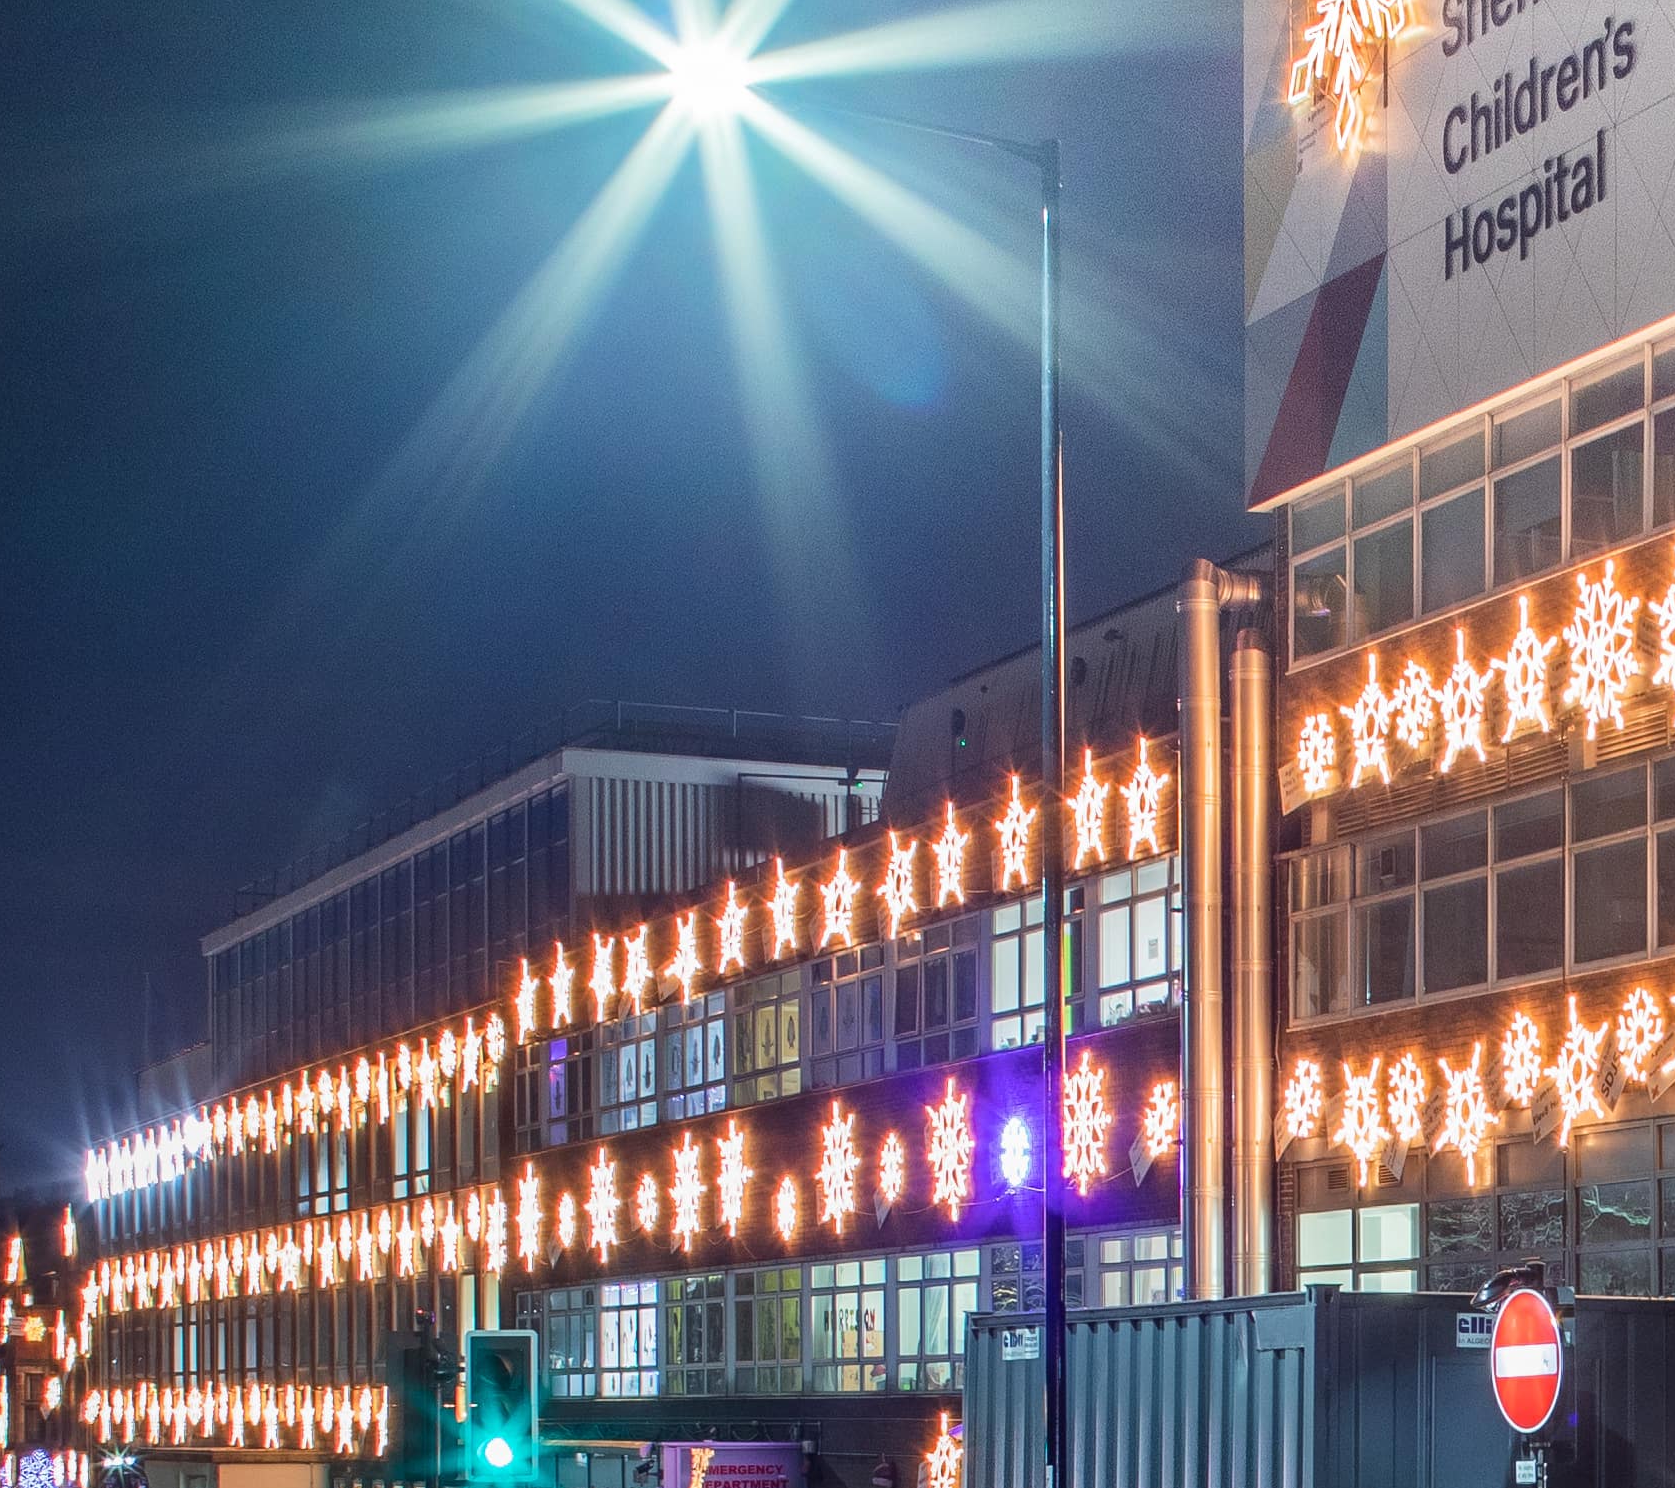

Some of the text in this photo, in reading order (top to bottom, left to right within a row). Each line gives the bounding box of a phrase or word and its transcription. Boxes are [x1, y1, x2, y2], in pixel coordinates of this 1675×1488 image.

[1442, 16, 1638, 174] Children's
[1444, 126, 1609, 280] Hospital
[1458, 1317, 1493, 1334] elli
[708, 1464, 784, 1475] MERGENCY
